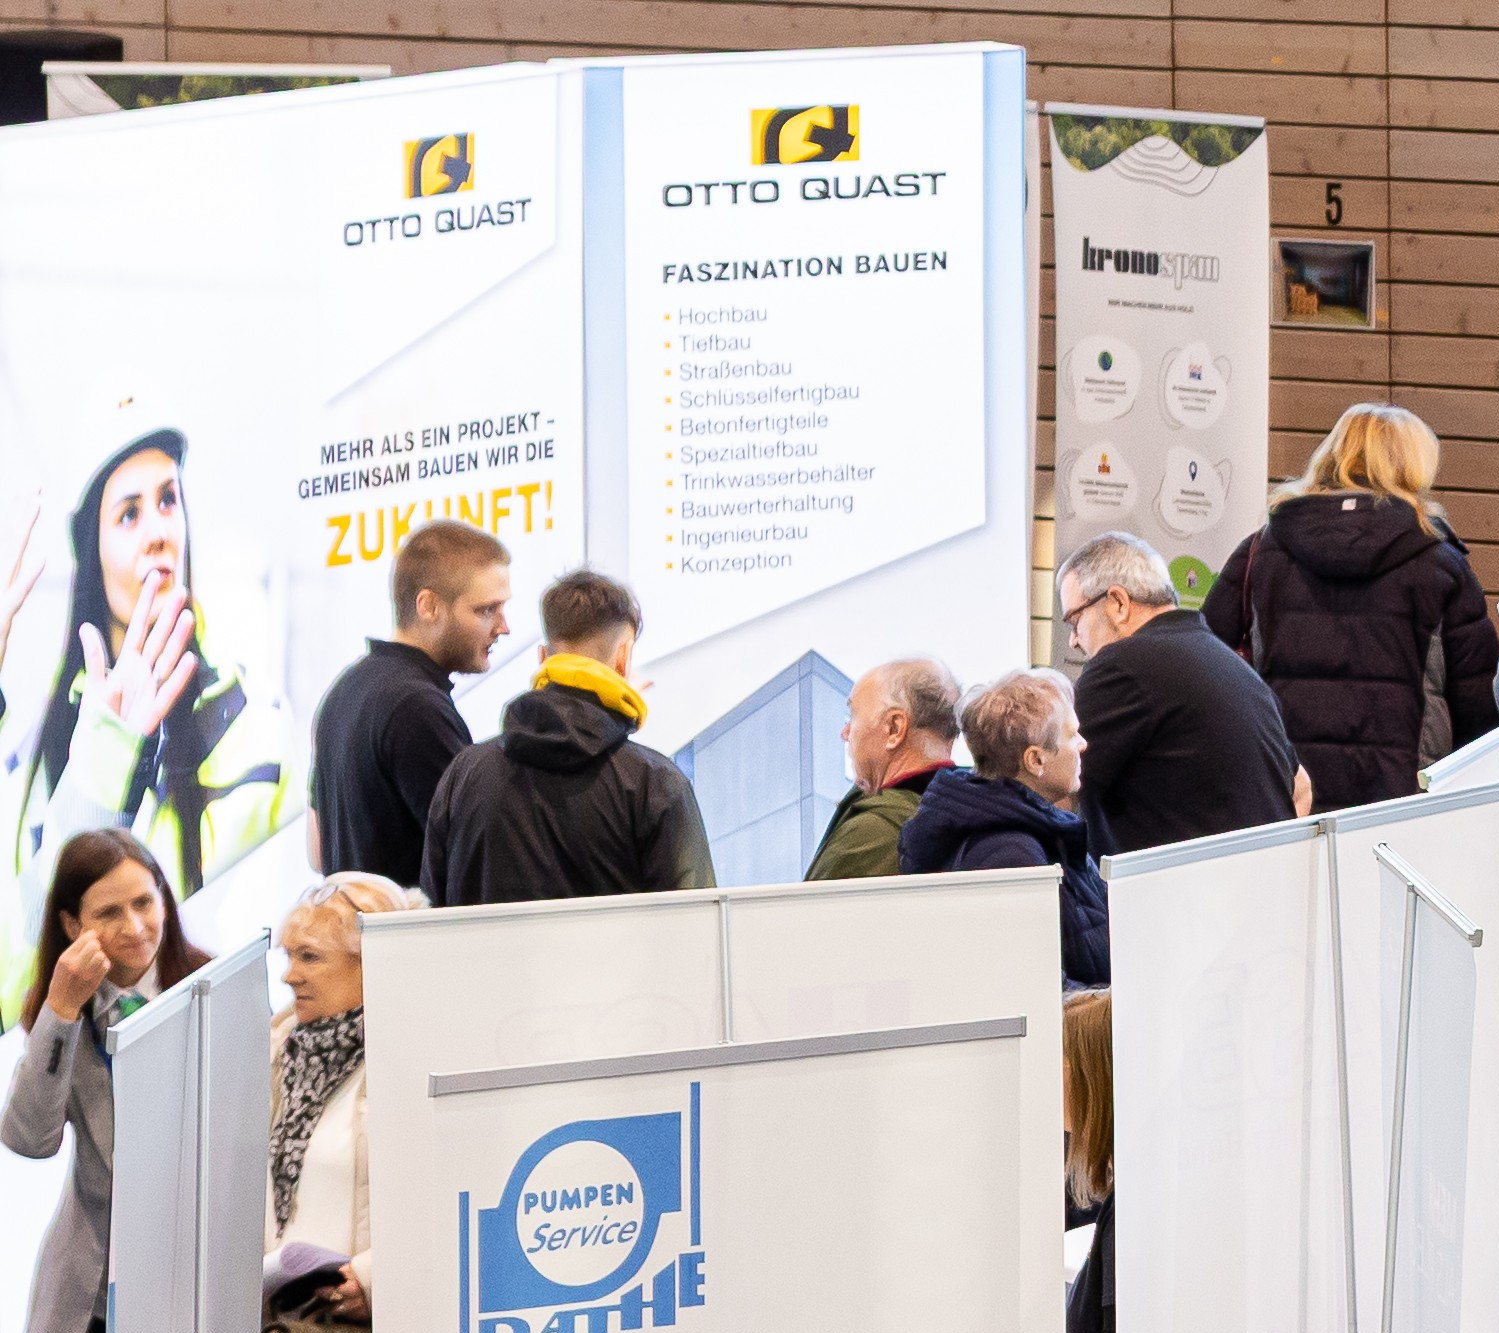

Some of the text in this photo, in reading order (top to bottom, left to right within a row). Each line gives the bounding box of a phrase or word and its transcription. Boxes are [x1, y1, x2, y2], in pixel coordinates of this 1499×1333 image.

[662, 172, 946, 208] OTTO QUAST
[1325, 183, 1343, 225] 5
[343, 199, 532, 247] OTTO QUAST
[662, 250, 947, 285] FASZINATION BAUEN
[679, 306, 768, 326] Hochbau
[680, 332, 751, 353] Tiefbau
[680, 359, 792, 381] Straßenbau
[680, 382, 859, 410] Schlüsselfertigbau
[321, 412, 540, 464] MEHR ALS EIN PROJEKT
[681, 411, 828, 437] Betonfertigteile
[681, 440, 818, 466] Spezialtiefbau
[299, 439, 554, 499] GEMEINSAM BAUEN WIR DIE
[682, 462, 875, 490] Trinkwasserbehälter
[682, 491, 854, 519] Bauwerterhaltung
[326, 480, 553, 568] ZUKNFT!
[682, 522, 808, 548] Ingenieurbau
[681, 550, 792, 574] Konzeption
[523, 1181, 634, 1216] PUMPEN
[526, 1216, 638, 1256] Service
